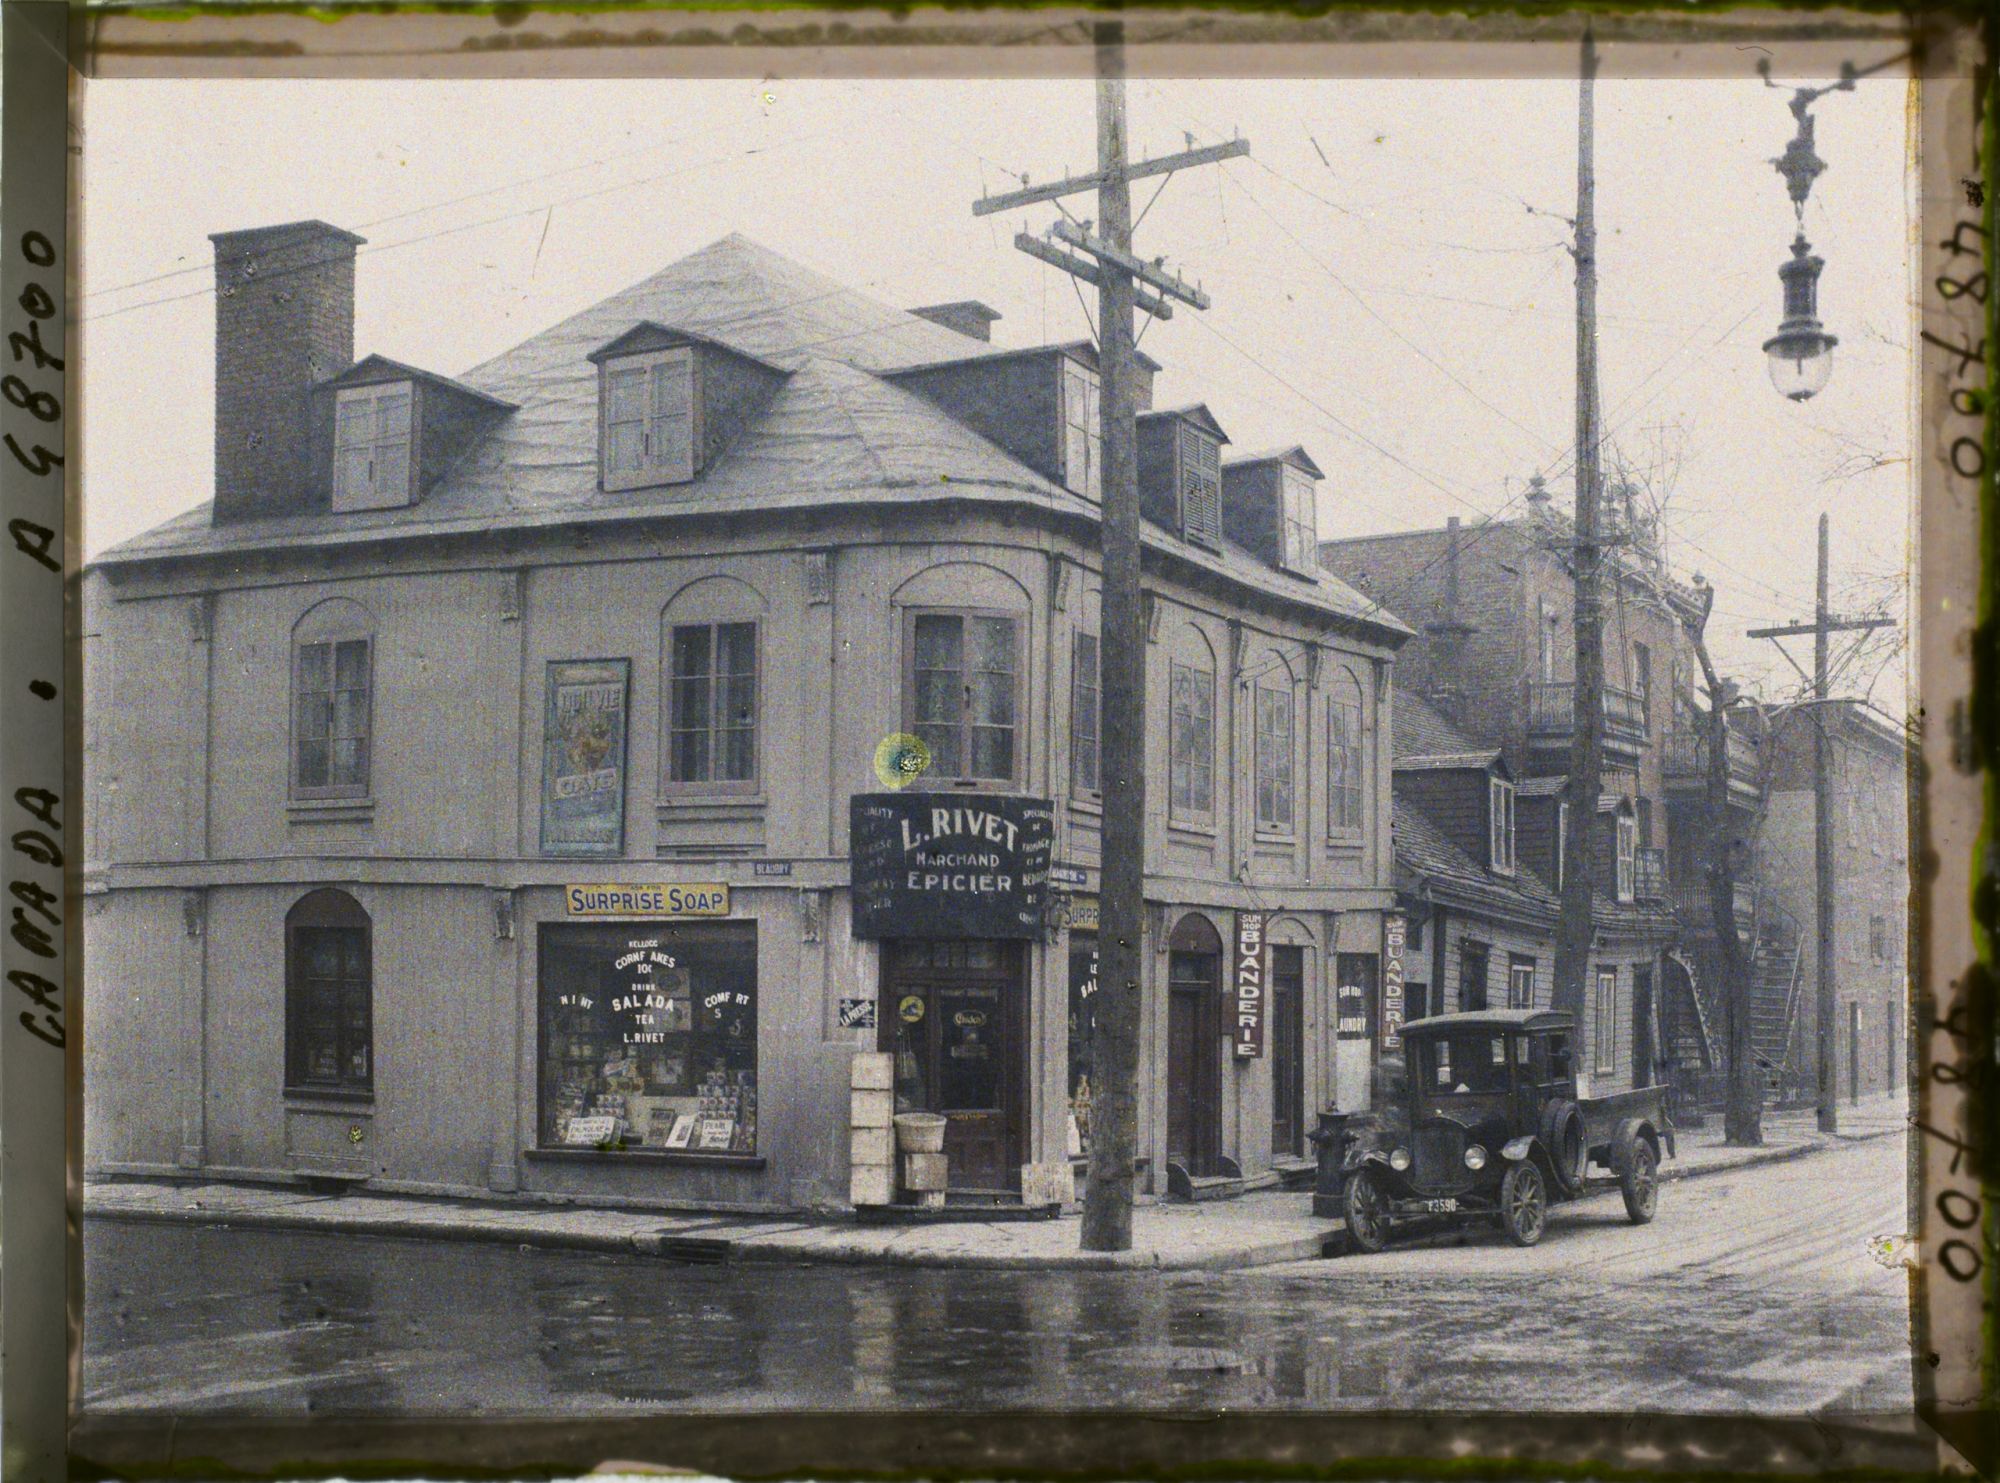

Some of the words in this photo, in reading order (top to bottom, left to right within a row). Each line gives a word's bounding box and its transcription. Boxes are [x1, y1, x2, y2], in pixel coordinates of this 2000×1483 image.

[932, 808, 1018, 853] RIVET
[916, 852, 1000, 868] MARCHAND
[907, 871, 1012, 892] EPICIER
[571, 889, 664, 912] SURPRISE
[669, 888, 723, 912] SOAP
[7, 788, 65, 1047] CANADA
[1237, 930, 1261, 1056] BUANDERIE
[1384, 933, 1404, 1048] BUANDERIE
[612, 994, 675, 1012] SALADA
[635, 1014, 655, 1025] TEA
[1337, 1017, 1367, 1032] AUNDRY
